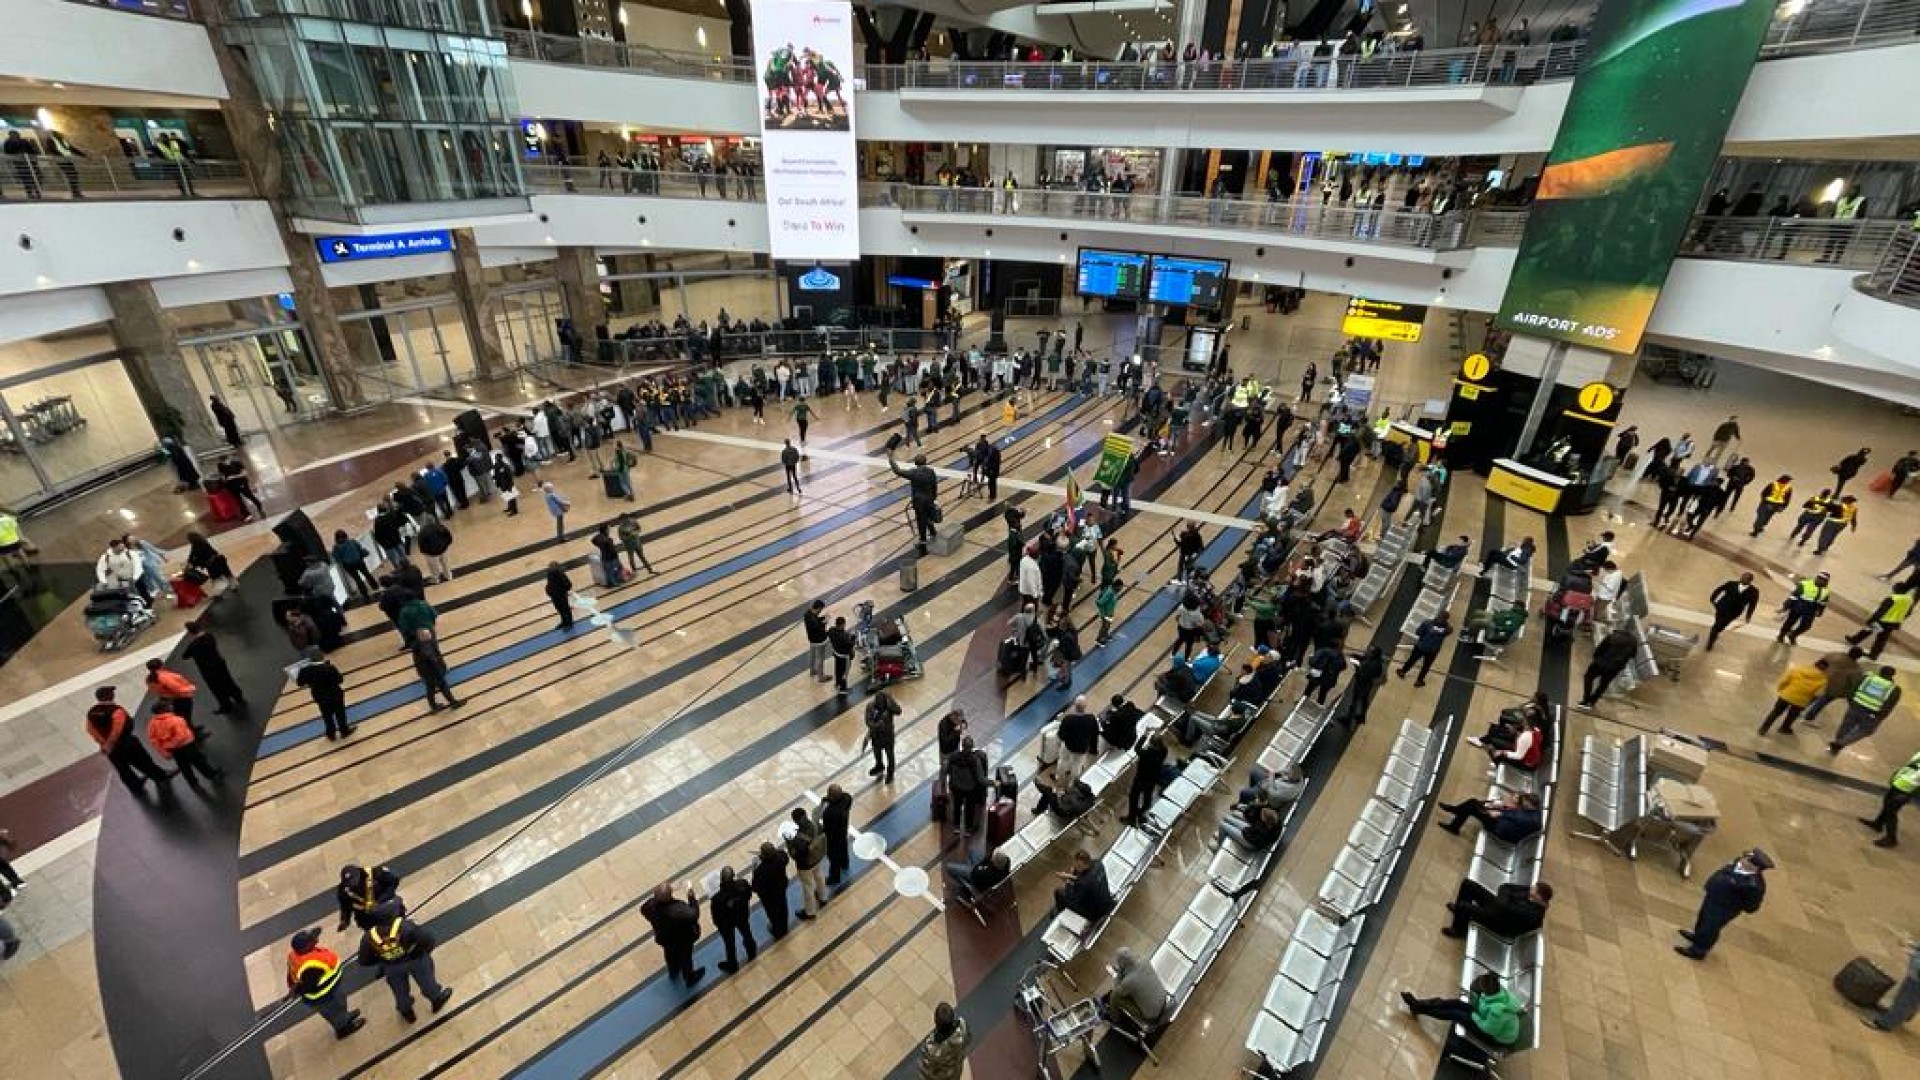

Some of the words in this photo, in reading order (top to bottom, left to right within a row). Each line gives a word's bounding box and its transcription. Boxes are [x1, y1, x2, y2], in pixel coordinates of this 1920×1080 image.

[810, 220, 822, 232] To
[824, 220, 845, 234] Win
[352, 240, 395, 253] Terminal
[397, 240, 405, 249] A
[408, 237, 442, 248] Arrivals
[1513, 313, 1580, 332] AIRPORT
[1583, 325, 1617, 340] ADS
